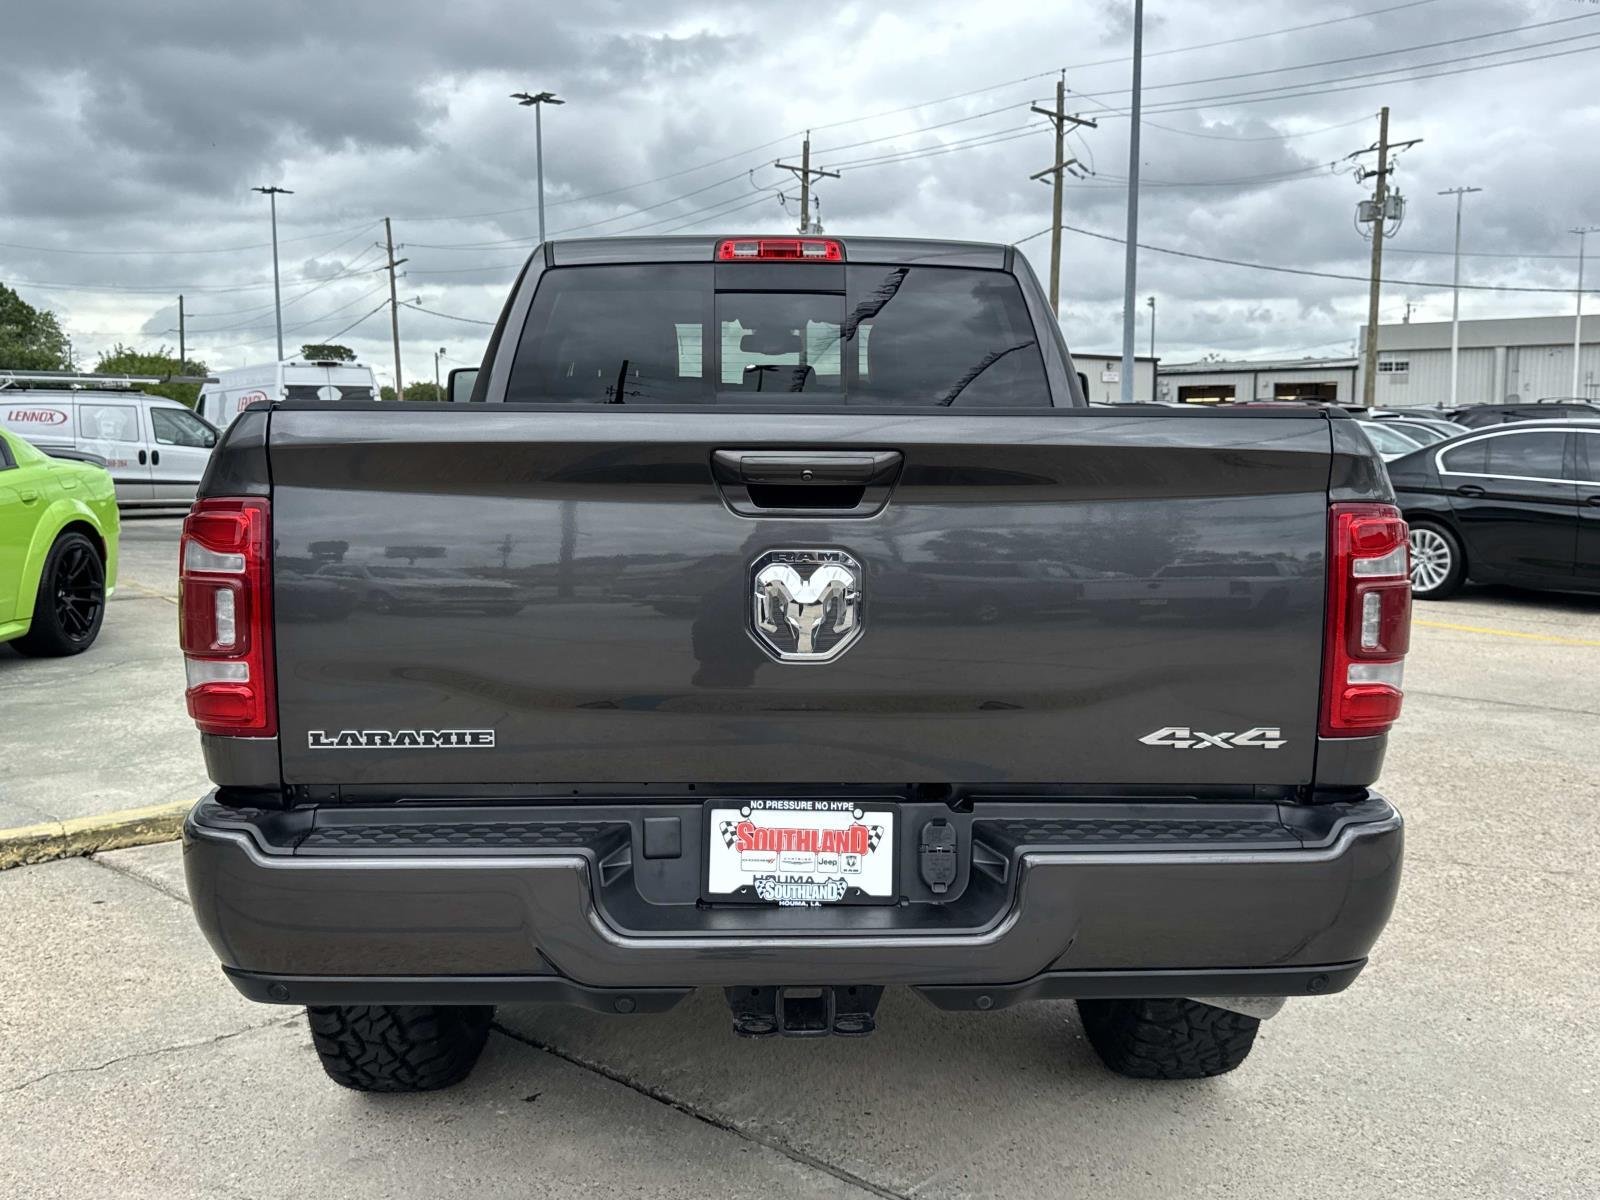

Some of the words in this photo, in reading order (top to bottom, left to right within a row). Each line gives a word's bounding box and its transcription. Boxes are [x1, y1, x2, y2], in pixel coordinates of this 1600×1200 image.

[8, 410, 55, 422] LENNOX
[772, 551, 840, 562] RAM
[308, 730, 495, 749] LARAMIE
[750, 800, 764, 809] NO
[766, 800, 813, 810] PRESSURE
[815, 801, 829, 810] NO
[830, 802, 854, 811] HYPE
[818, 858, 838, 867] Jeep
[764, 880, 838, 900] SOUTHLAND
